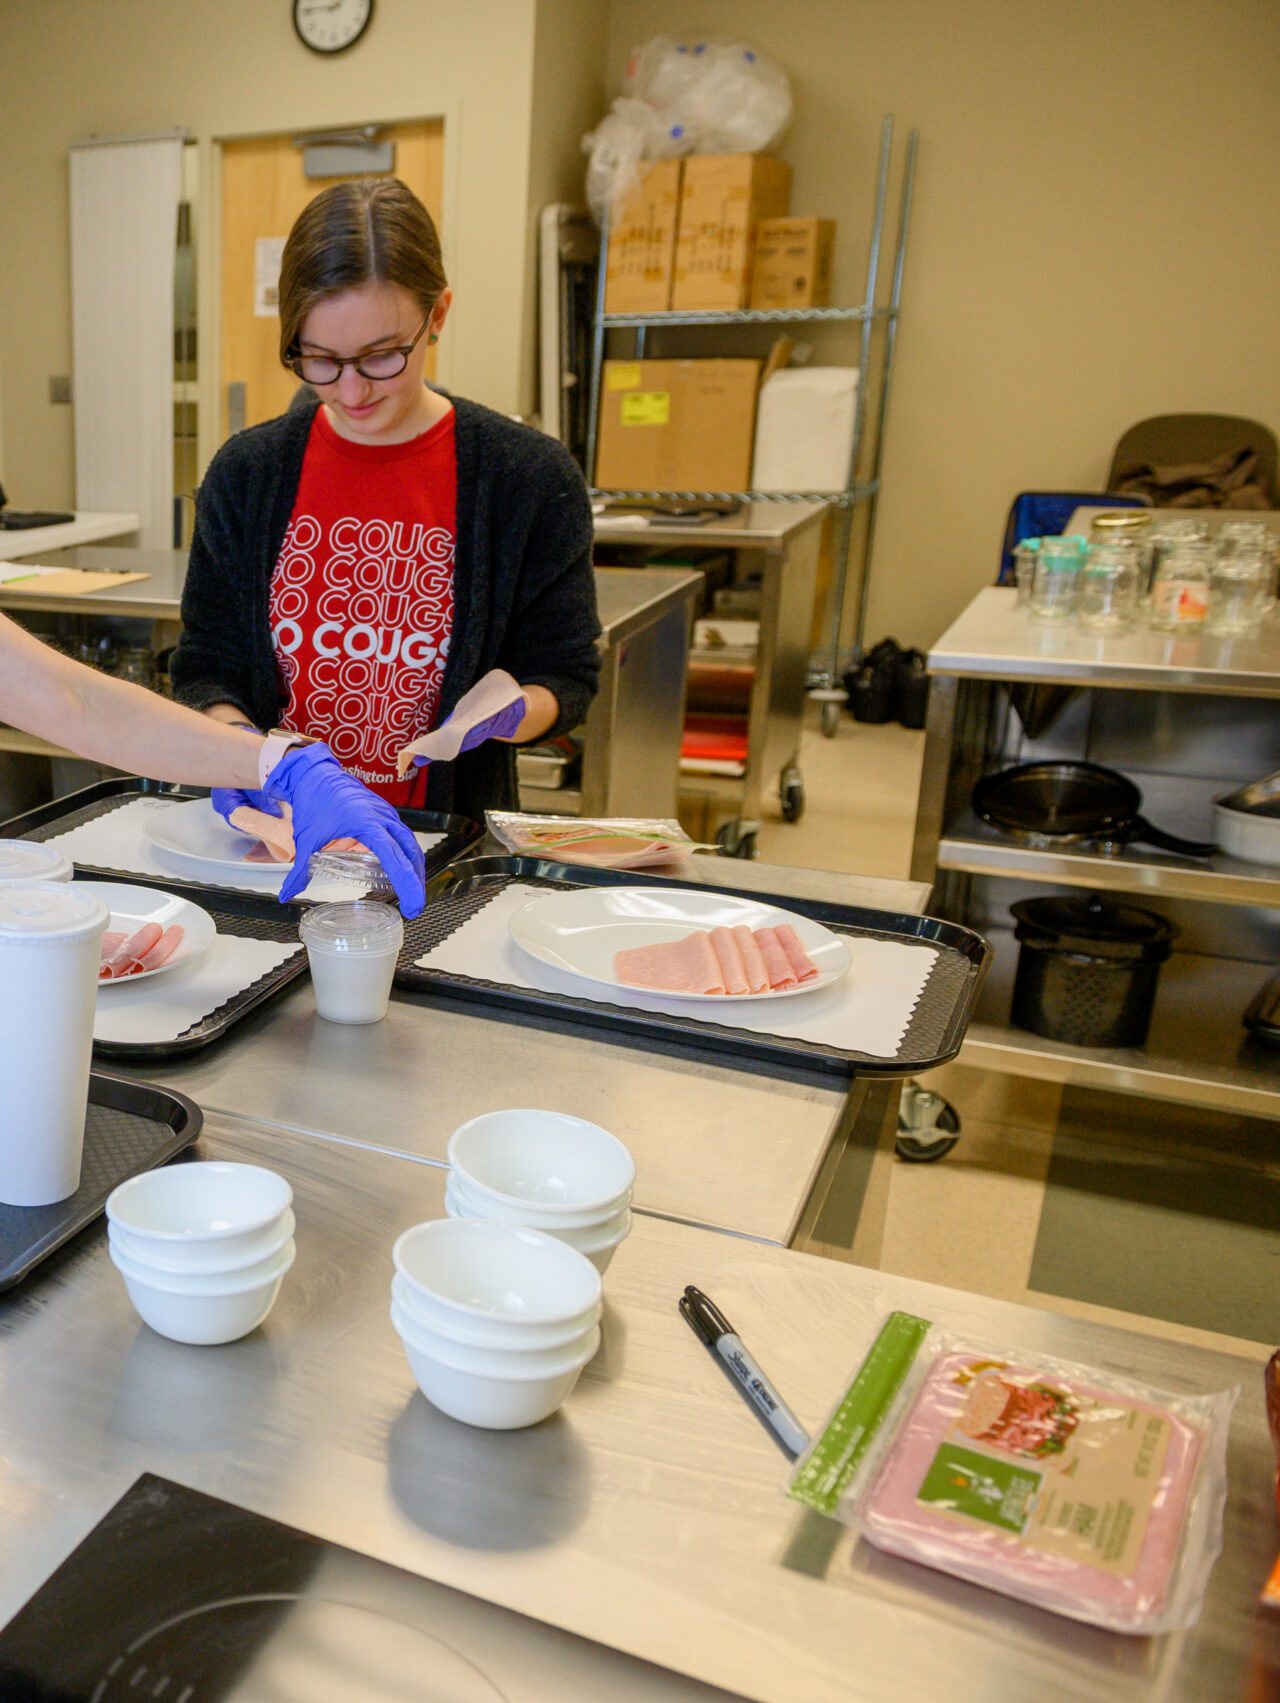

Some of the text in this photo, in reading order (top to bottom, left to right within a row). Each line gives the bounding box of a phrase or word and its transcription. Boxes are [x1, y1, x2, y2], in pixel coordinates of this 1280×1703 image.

[329, 517, 456, 565] COUG
[323, 553, 455, 601] COUG
[340, 763, 394, 785] ashington
